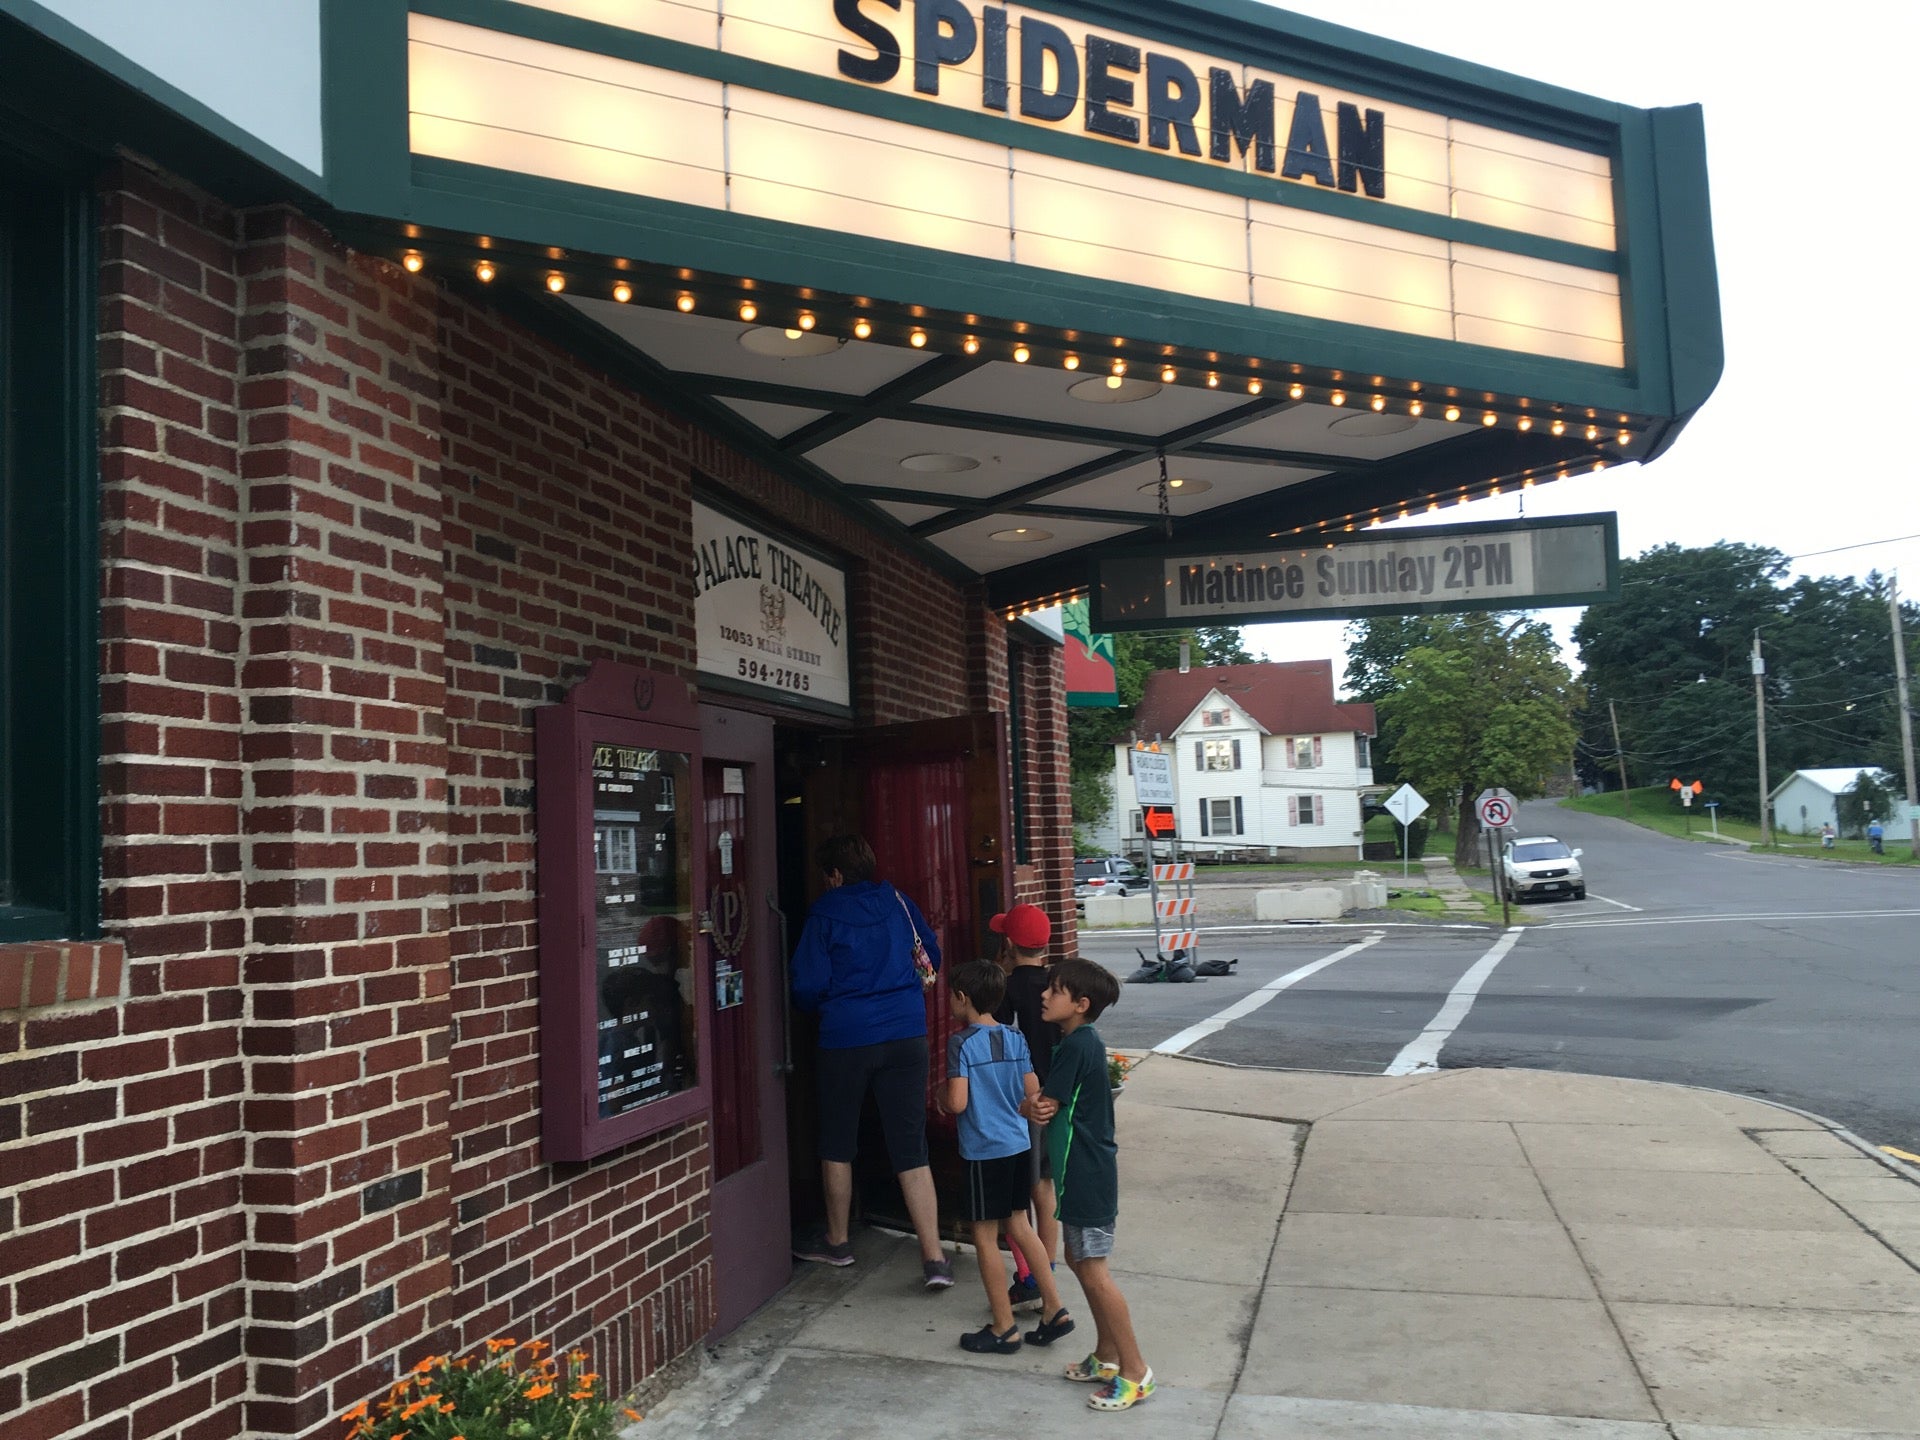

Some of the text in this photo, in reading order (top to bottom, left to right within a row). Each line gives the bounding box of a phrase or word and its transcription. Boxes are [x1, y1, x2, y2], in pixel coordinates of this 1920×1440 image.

[833, 0, 1385, 199] SPIDERMAN
[693, 535, 842, 648] PALACE THEATRE
[1179, 543, 1513, 605] Matinee Sunday 2PM
[719, 625, 821, 666] 12053 MAIN STREET
